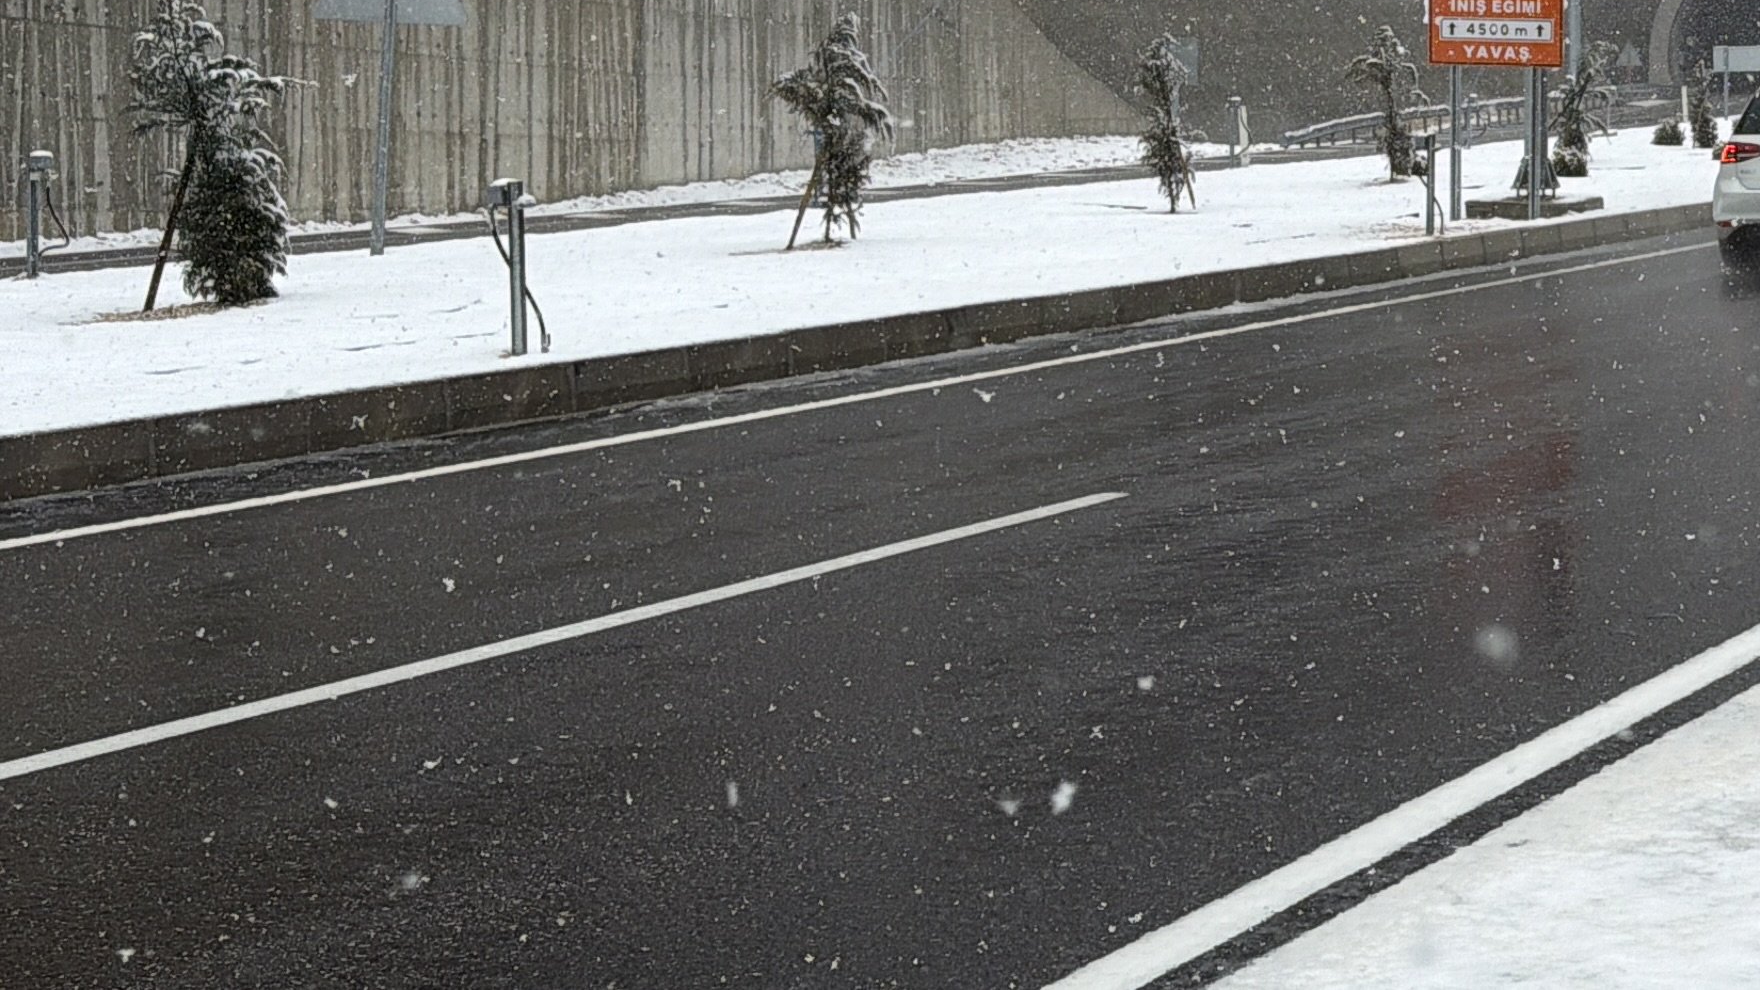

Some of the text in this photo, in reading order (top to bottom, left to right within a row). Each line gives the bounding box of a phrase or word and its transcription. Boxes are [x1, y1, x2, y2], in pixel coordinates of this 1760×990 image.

[1466, 22, 1528, 36] 4500 m
[1463, 44, 1530, 62] YAVAŞ
